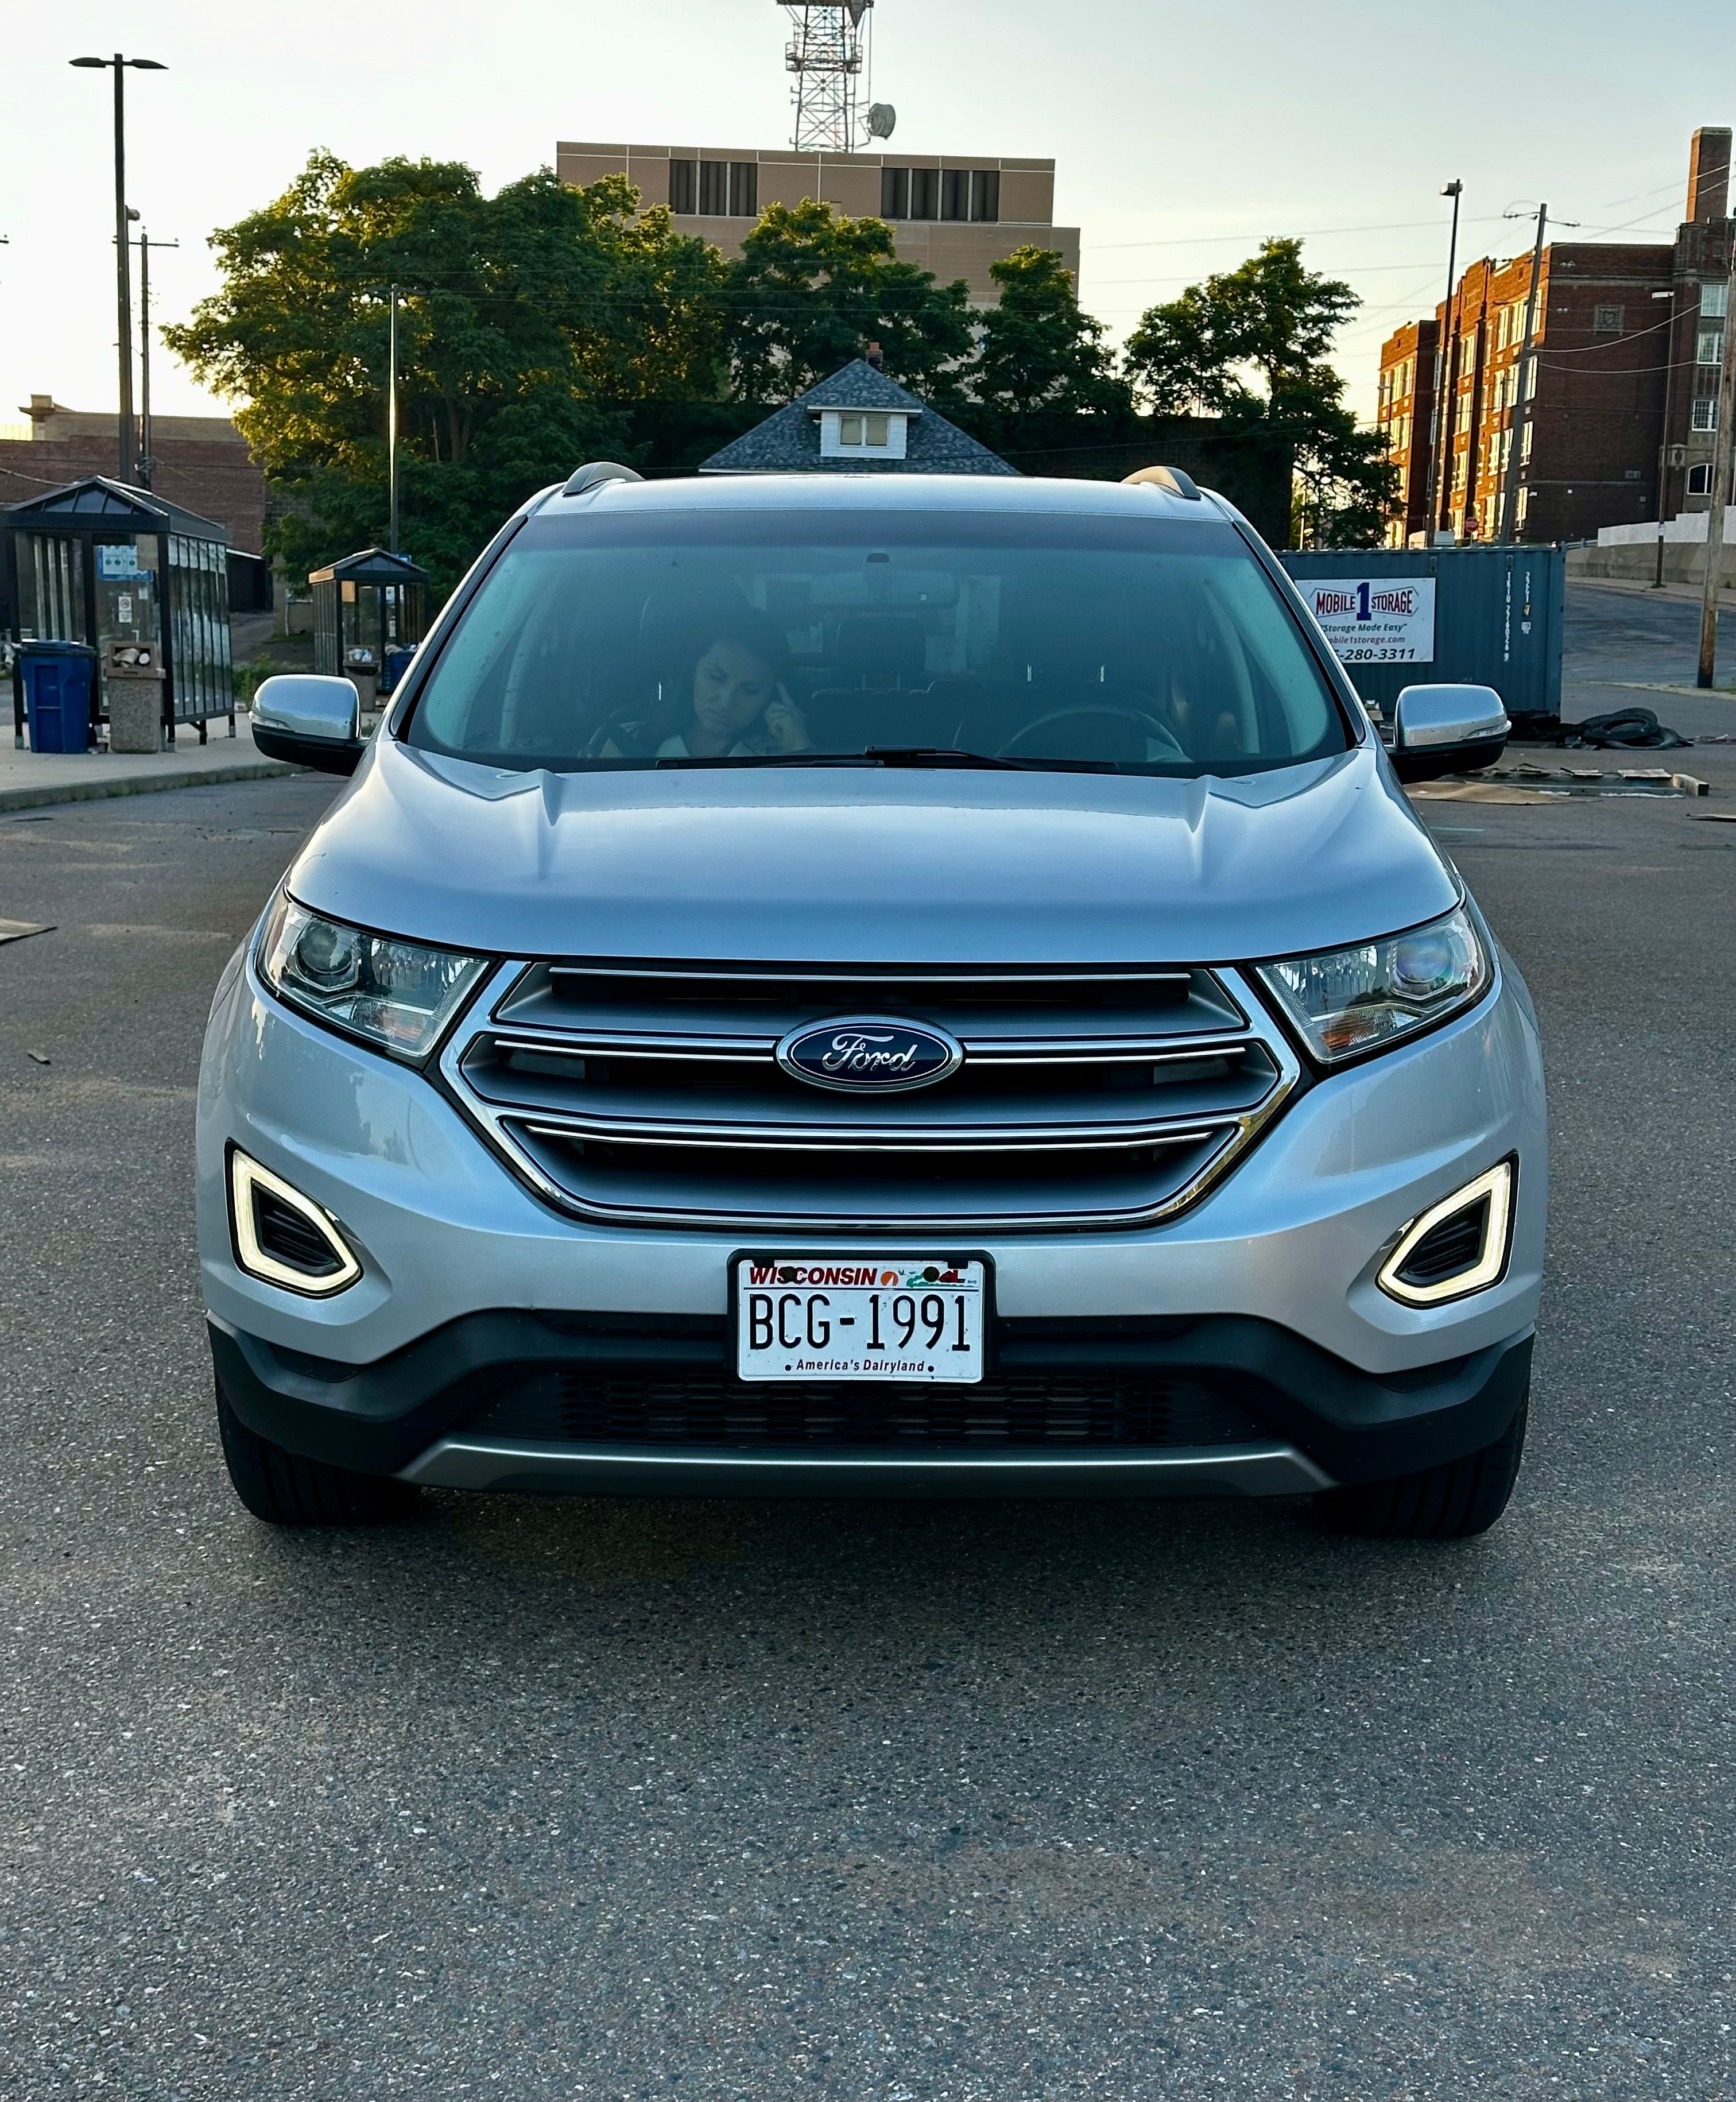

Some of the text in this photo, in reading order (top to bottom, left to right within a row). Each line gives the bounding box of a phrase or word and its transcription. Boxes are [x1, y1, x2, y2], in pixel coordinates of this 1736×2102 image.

[1316, 582, 1413, 621] MOBILE 1 STORAGE
[1358, 624, 1381, 632] Made
[1328, 636, 1405, 645] obile1storage.com
[1335, 649, 1415, 660] -280-3311
[822, 1033, 918, 1071] Ford
[750, 1267, 878, 1286] WISCONSIN
[750, 1294, 970, 1352] BCG-1991
[796, 1358, 925, 1374] America's Dairyland
